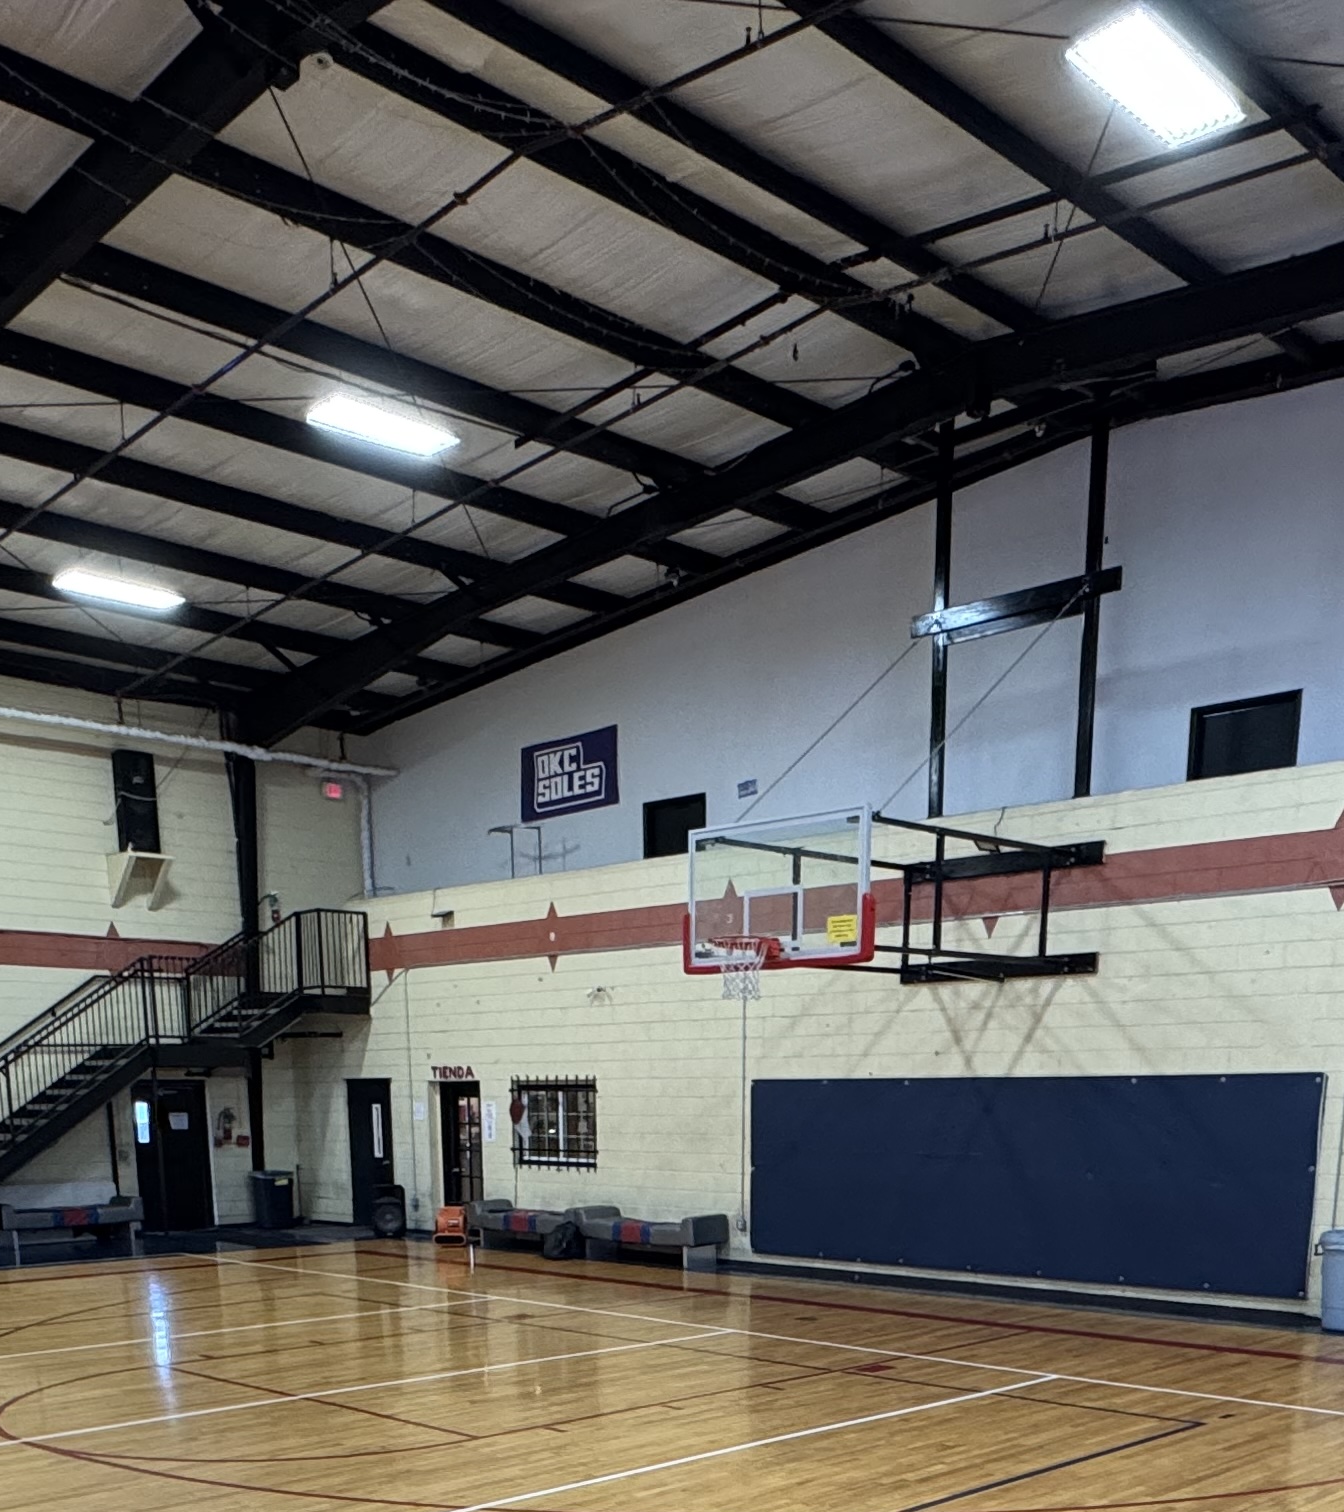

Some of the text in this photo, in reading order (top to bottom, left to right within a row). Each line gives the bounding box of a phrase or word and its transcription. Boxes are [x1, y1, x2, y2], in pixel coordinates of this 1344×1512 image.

[537, 748, 578, 778] OKC
[537, 768, 601, 803] SOLES
[431, 1066, 475, 1079] TIENDA
